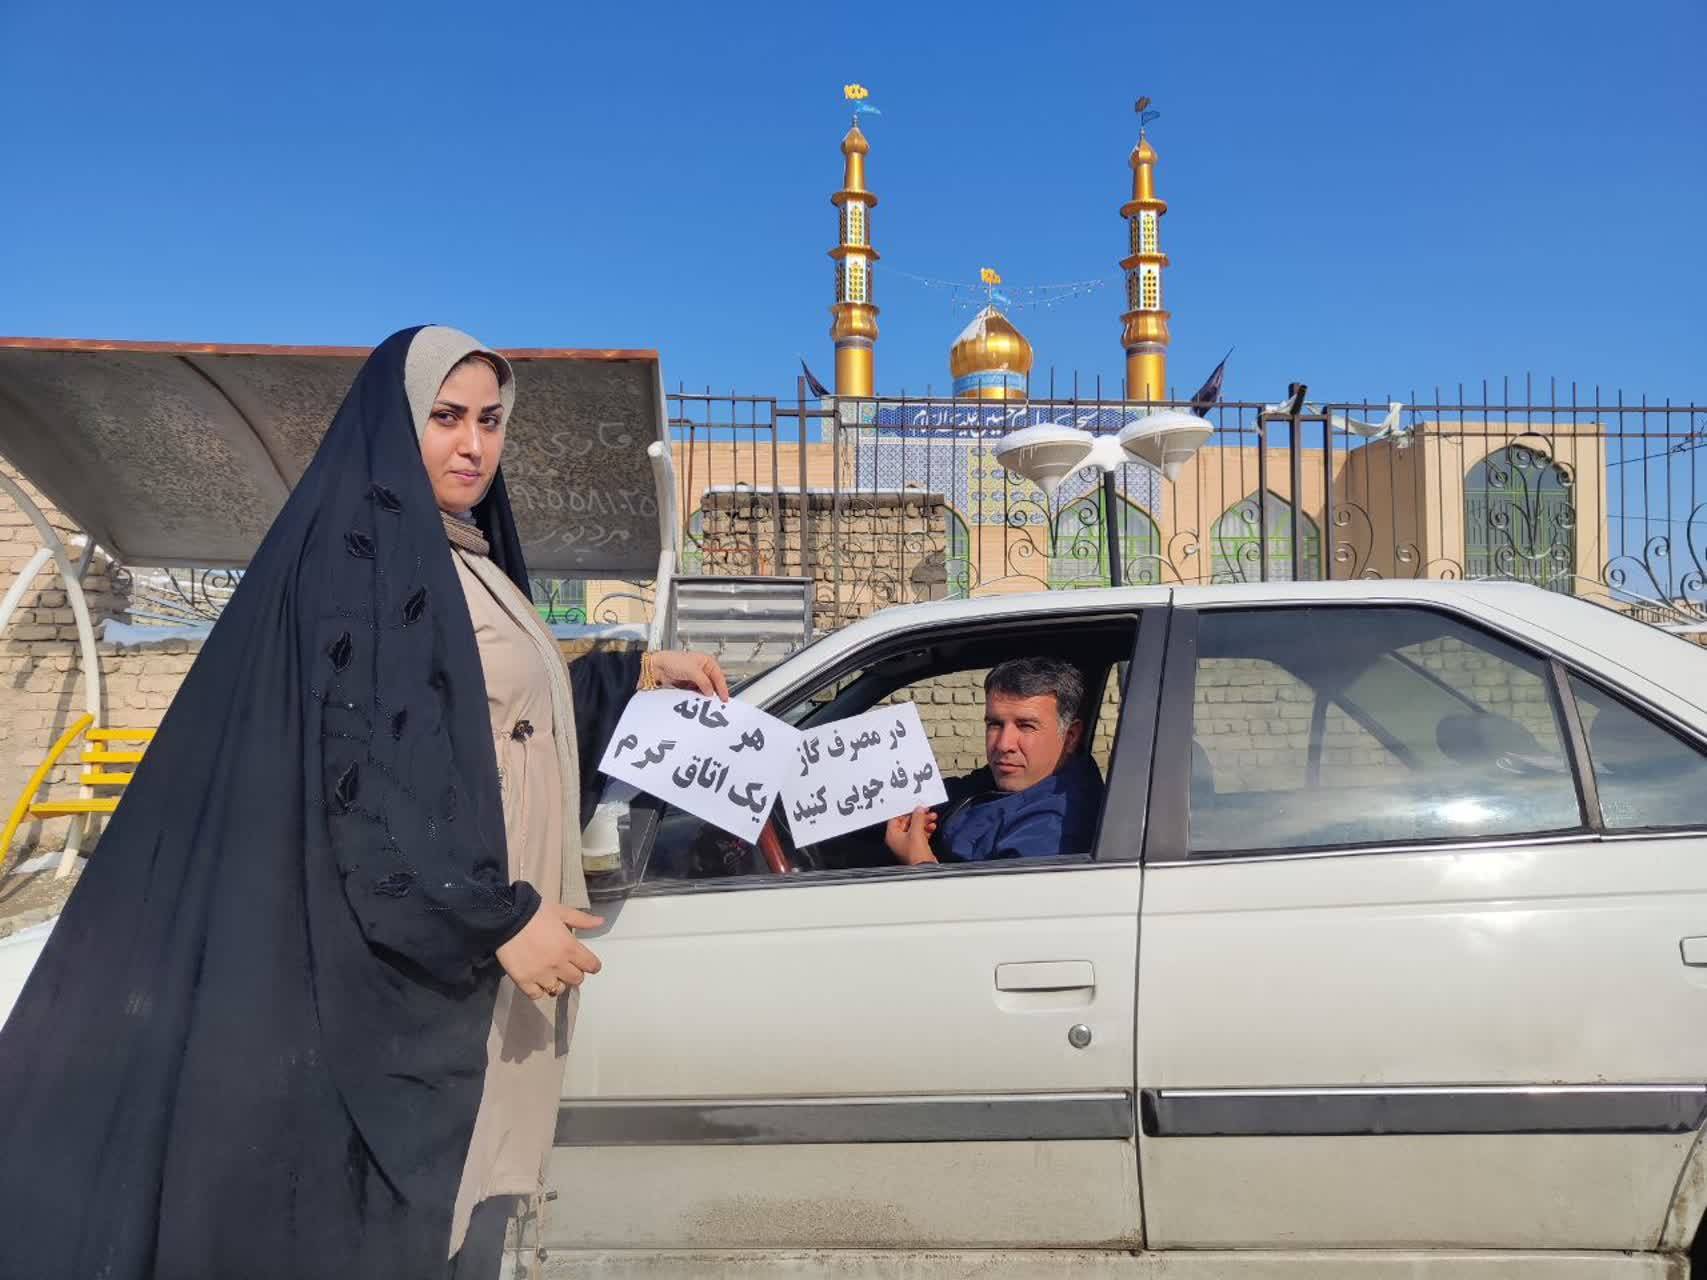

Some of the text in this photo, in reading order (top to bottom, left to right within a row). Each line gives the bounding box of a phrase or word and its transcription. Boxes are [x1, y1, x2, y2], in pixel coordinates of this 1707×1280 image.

[672, 696, 766, 754] هر خانه
[796, 719, 907, 777] در مصرف گاز
[613, 733, 769, 824] یک اتاق گرم
[792, 760, 933, 825] صرفه جویی کنید
